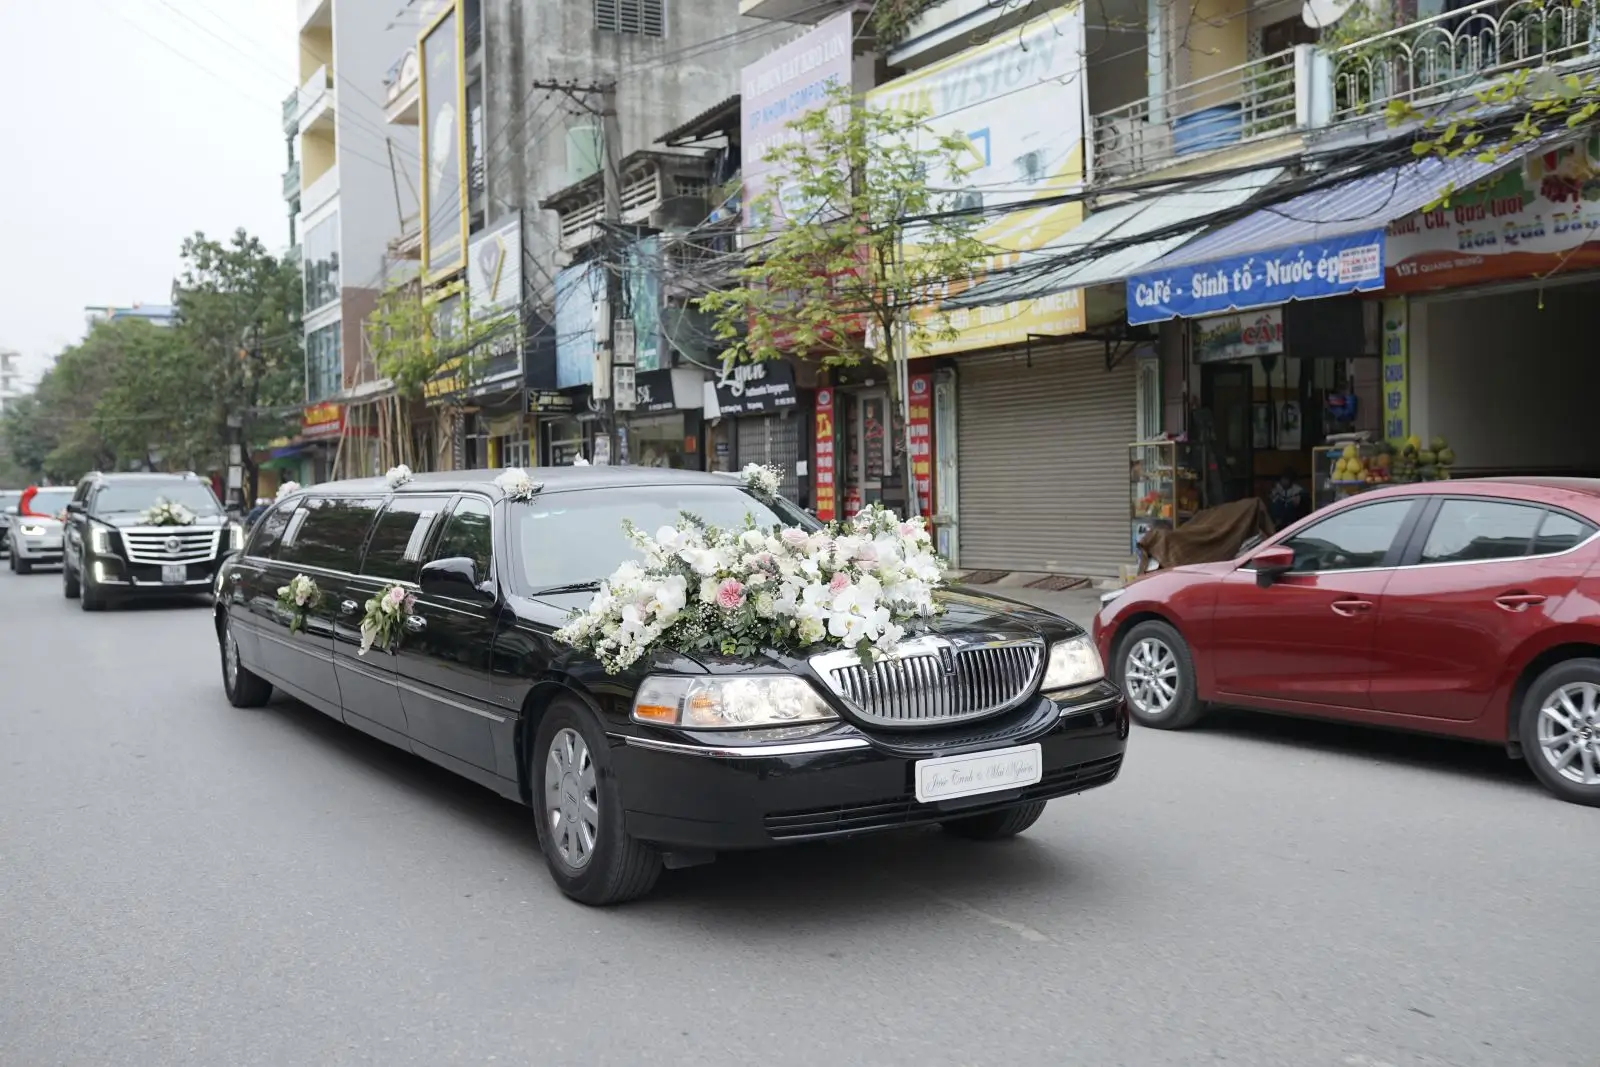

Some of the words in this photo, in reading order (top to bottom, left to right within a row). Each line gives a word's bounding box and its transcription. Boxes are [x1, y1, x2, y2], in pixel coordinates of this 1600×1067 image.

[941, 42, 1056, 113] VISION
[1191, 269, 1229, 299] Sinh
[1232, 257, 1255, 292] tố
